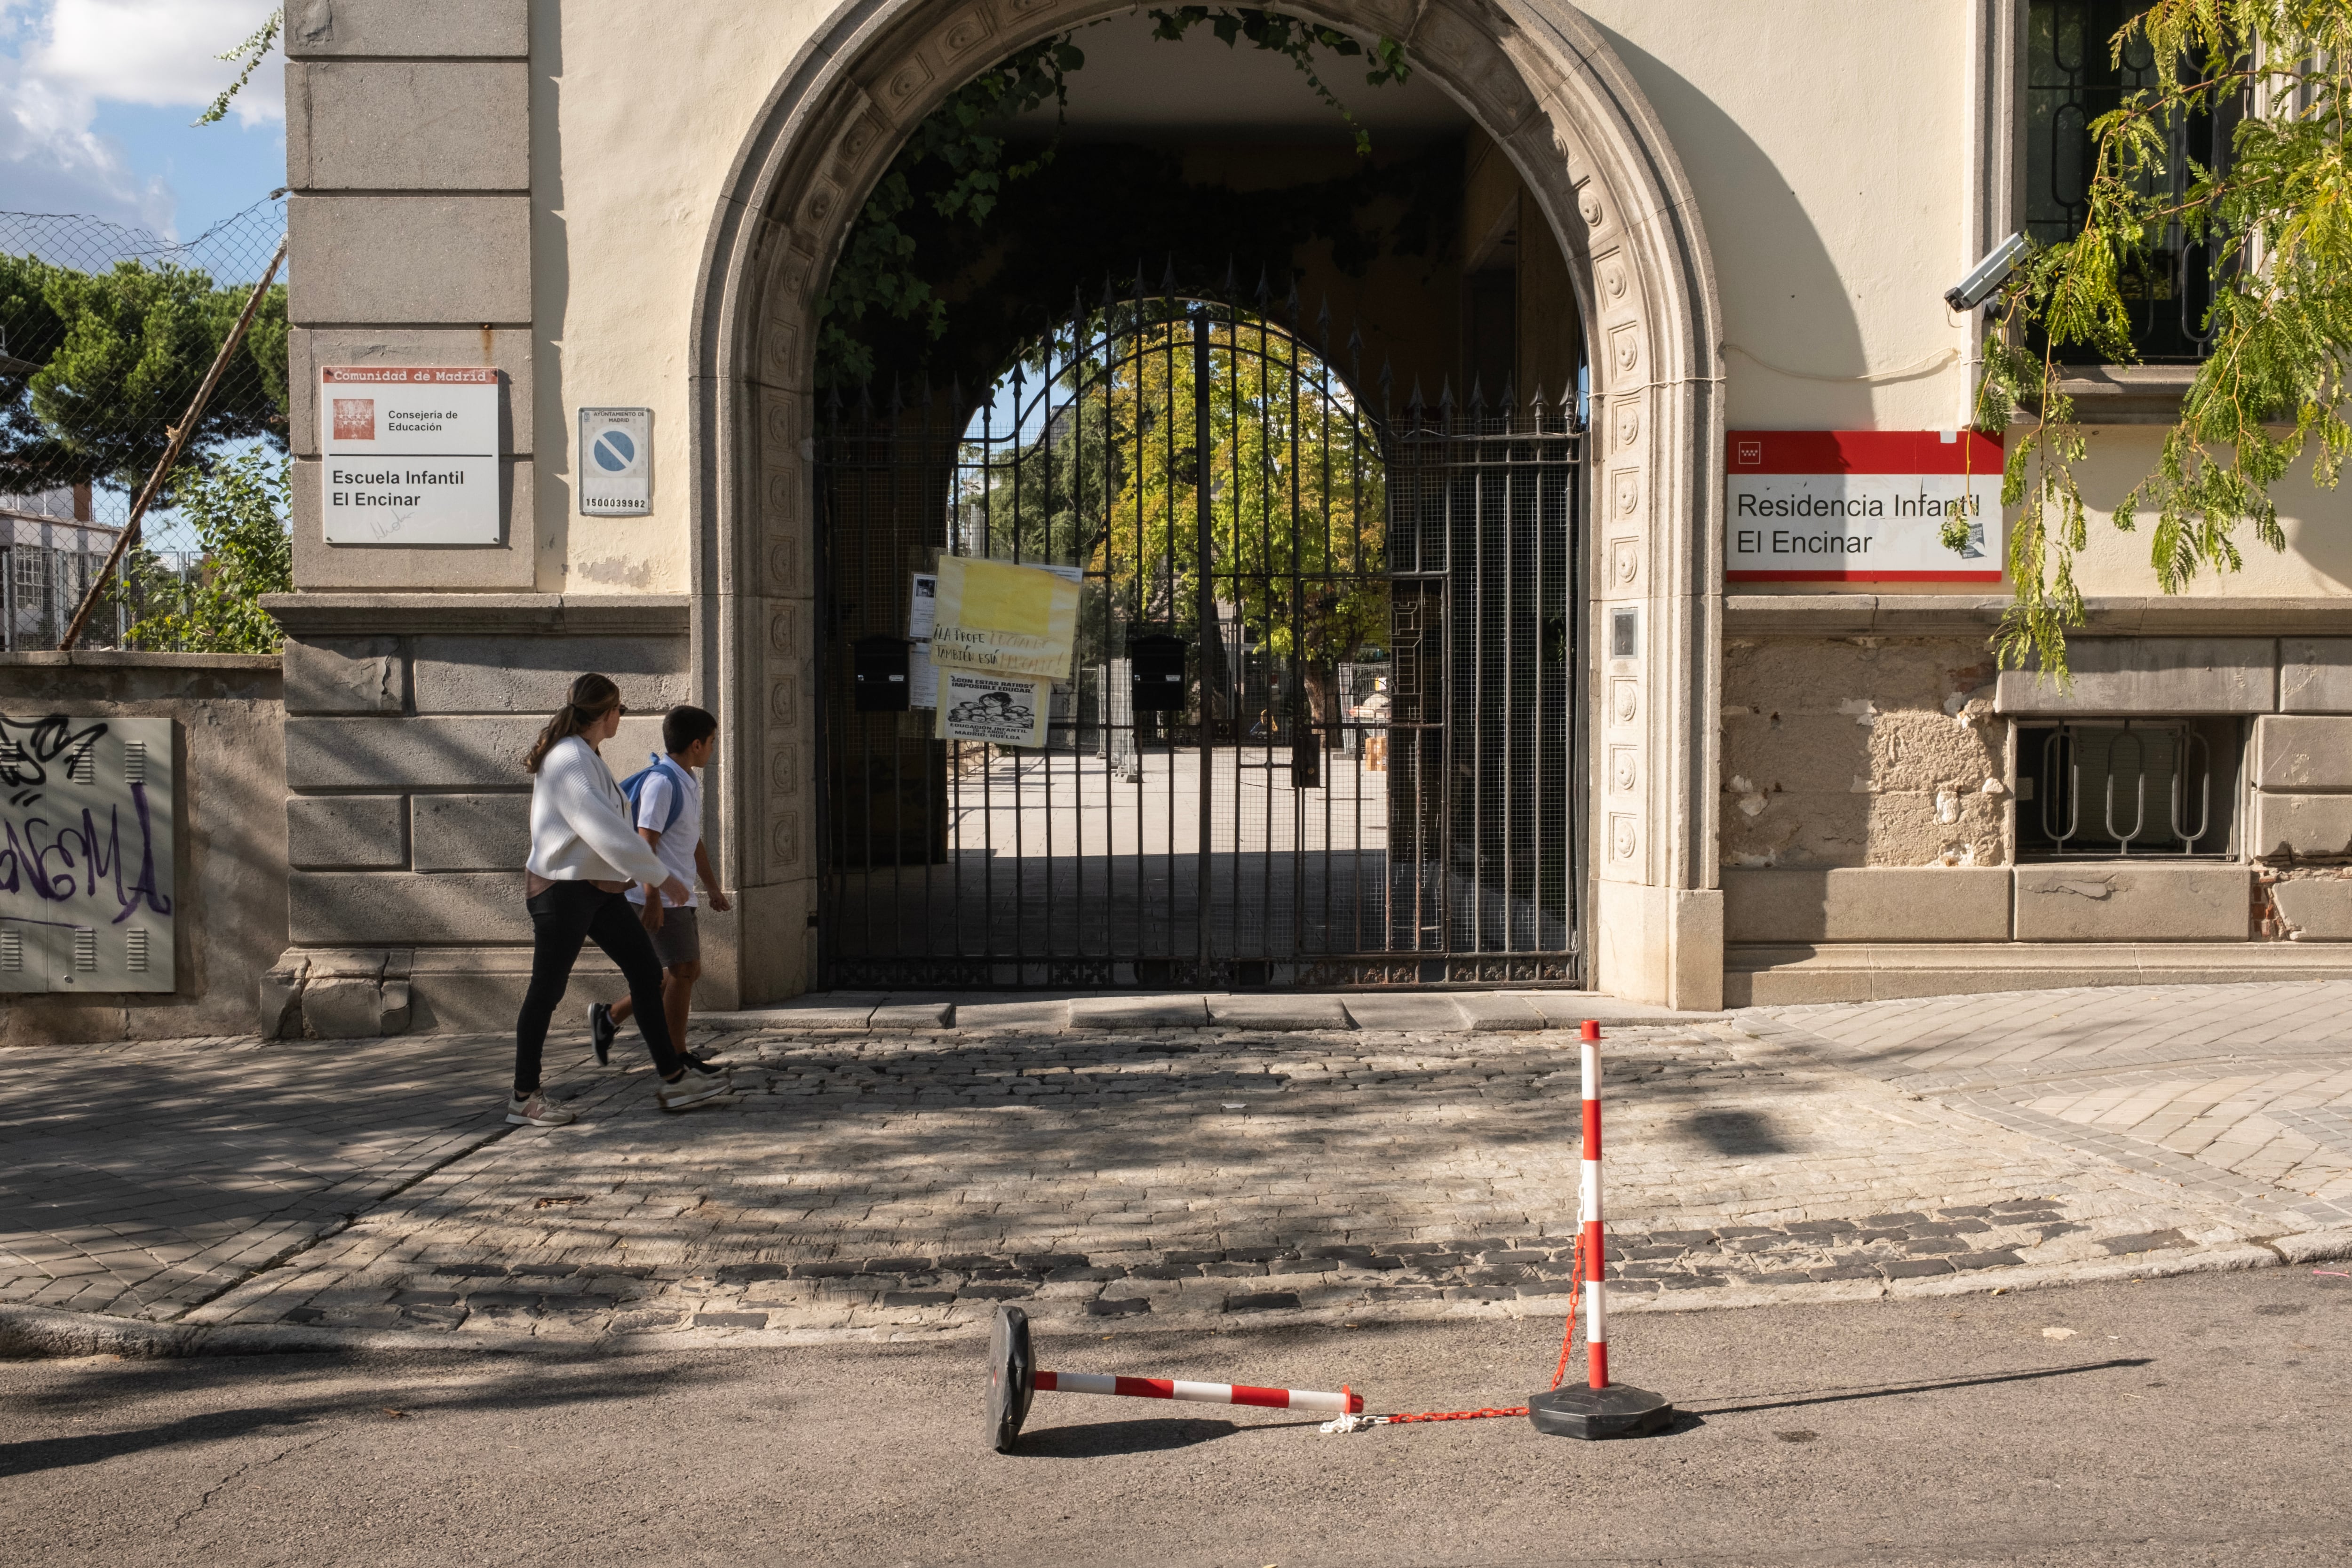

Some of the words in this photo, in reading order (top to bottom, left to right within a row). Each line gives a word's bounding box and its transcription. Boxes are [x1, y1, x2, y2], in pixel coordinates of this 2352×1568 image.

[334, 371, 407, 381] Comunidad
[413, 371, 430, 382] de
[436, 371, 486, 382] Madrid
[388, 410, 443, 421] Consejería
[445, 411, 458, 419] de
[389, 422, 442, 431] Educación
[333, 470, 400, 485] Escuela
[406, 470, 464, 485] Infantil
[333, 492, 349, 506] El
[355, 492, 421, 507] Encinar
[586, 499, 645, 508] 1500039982
[1739, 494, 1883, 517] Residencia
[1738, 531, 1761, 553] El
[1772, 531, 1873, 553] Encinar
[953, 628, 985, 643] PROFE
[936, 645, 974, 661] TAMBIÉN
[978, 649, 999, 664] ESTÁ
[952, 682, 996, 691] IMPOSIBLE
